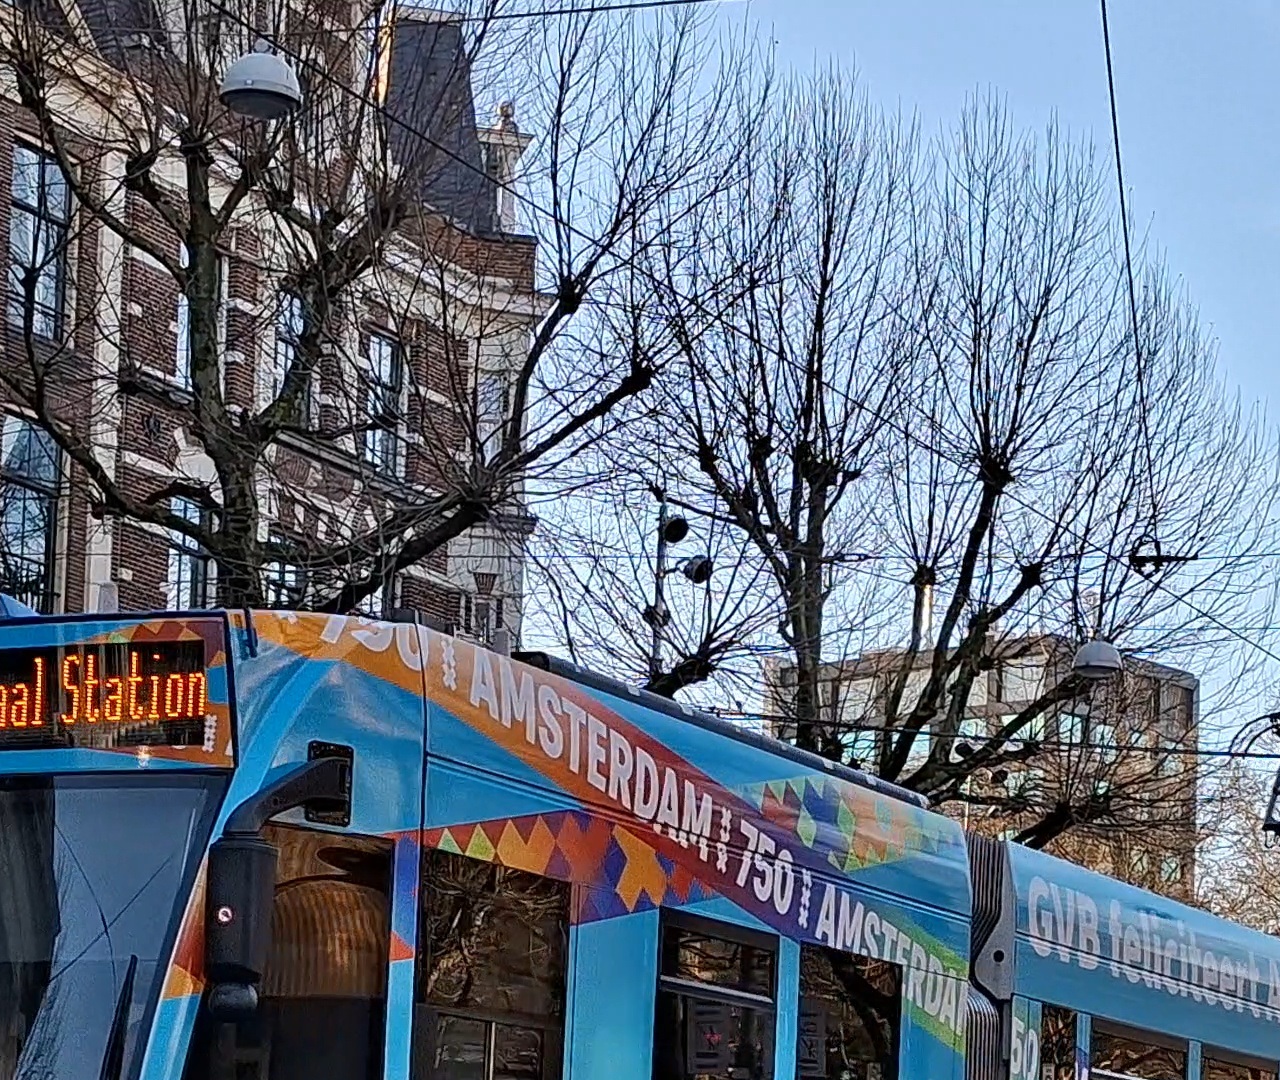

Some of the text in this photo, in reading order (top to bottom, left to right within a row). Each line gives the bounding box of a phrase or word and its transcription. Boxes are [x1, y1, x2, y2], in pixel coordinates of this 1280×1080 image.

[61, 651, 206, 724] Station
[470, 649, 713, 862] AMSTERDAM
[736, 819, 794, 914] 750
[1029, 876, 1101, 971] GVB
